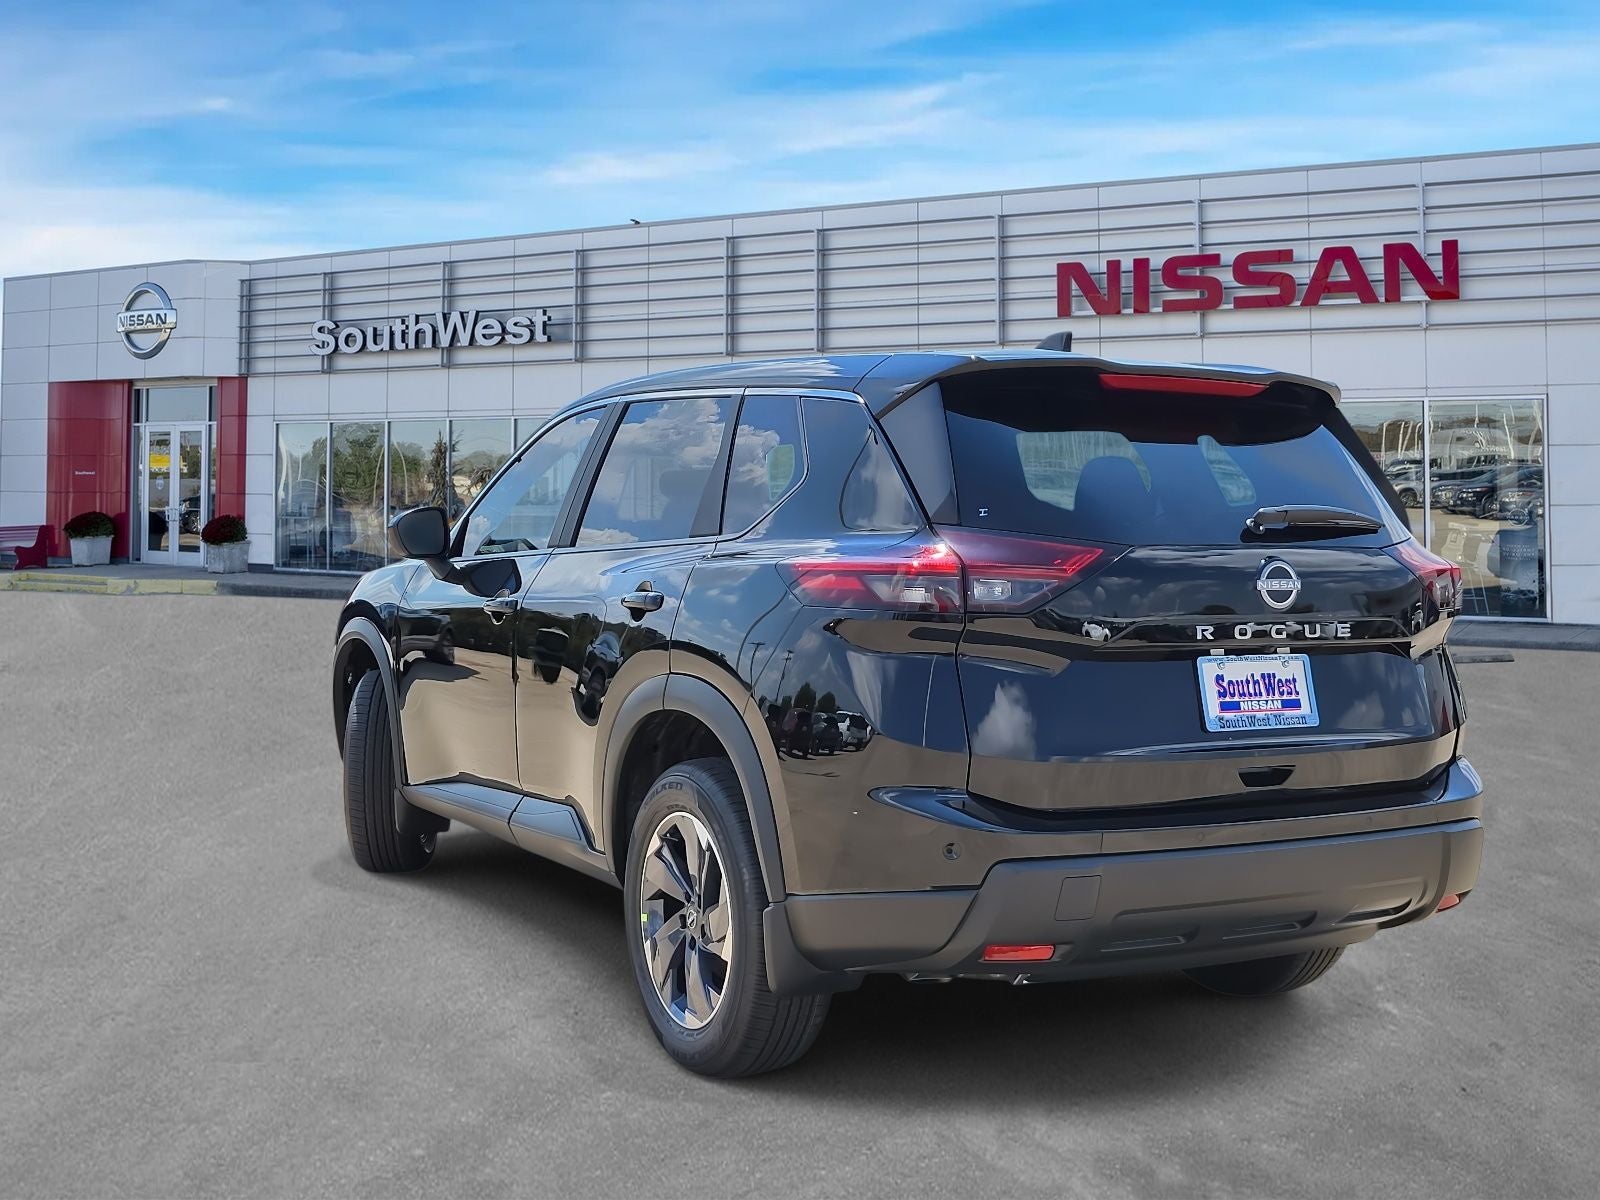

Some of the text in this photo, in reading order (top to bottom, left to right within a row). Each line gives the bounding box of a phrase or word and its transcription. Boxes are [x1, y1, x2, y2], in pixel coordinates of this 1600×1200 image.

[1056, 239, 1461, 318] NISSAN
[119, 313, 168, 328] NISSAN
[310, 308, 551, 356] SouthWest
[1258, 581, 1301, 590] NISSAN
[1196, 624, 1351, 640] ROGUE
[1215, 673, 1300, 699] SouthWest
[1239, 700, 1282, 711] NISSAN
[1219, 713, 1307, 729] SouthWest Nissan
